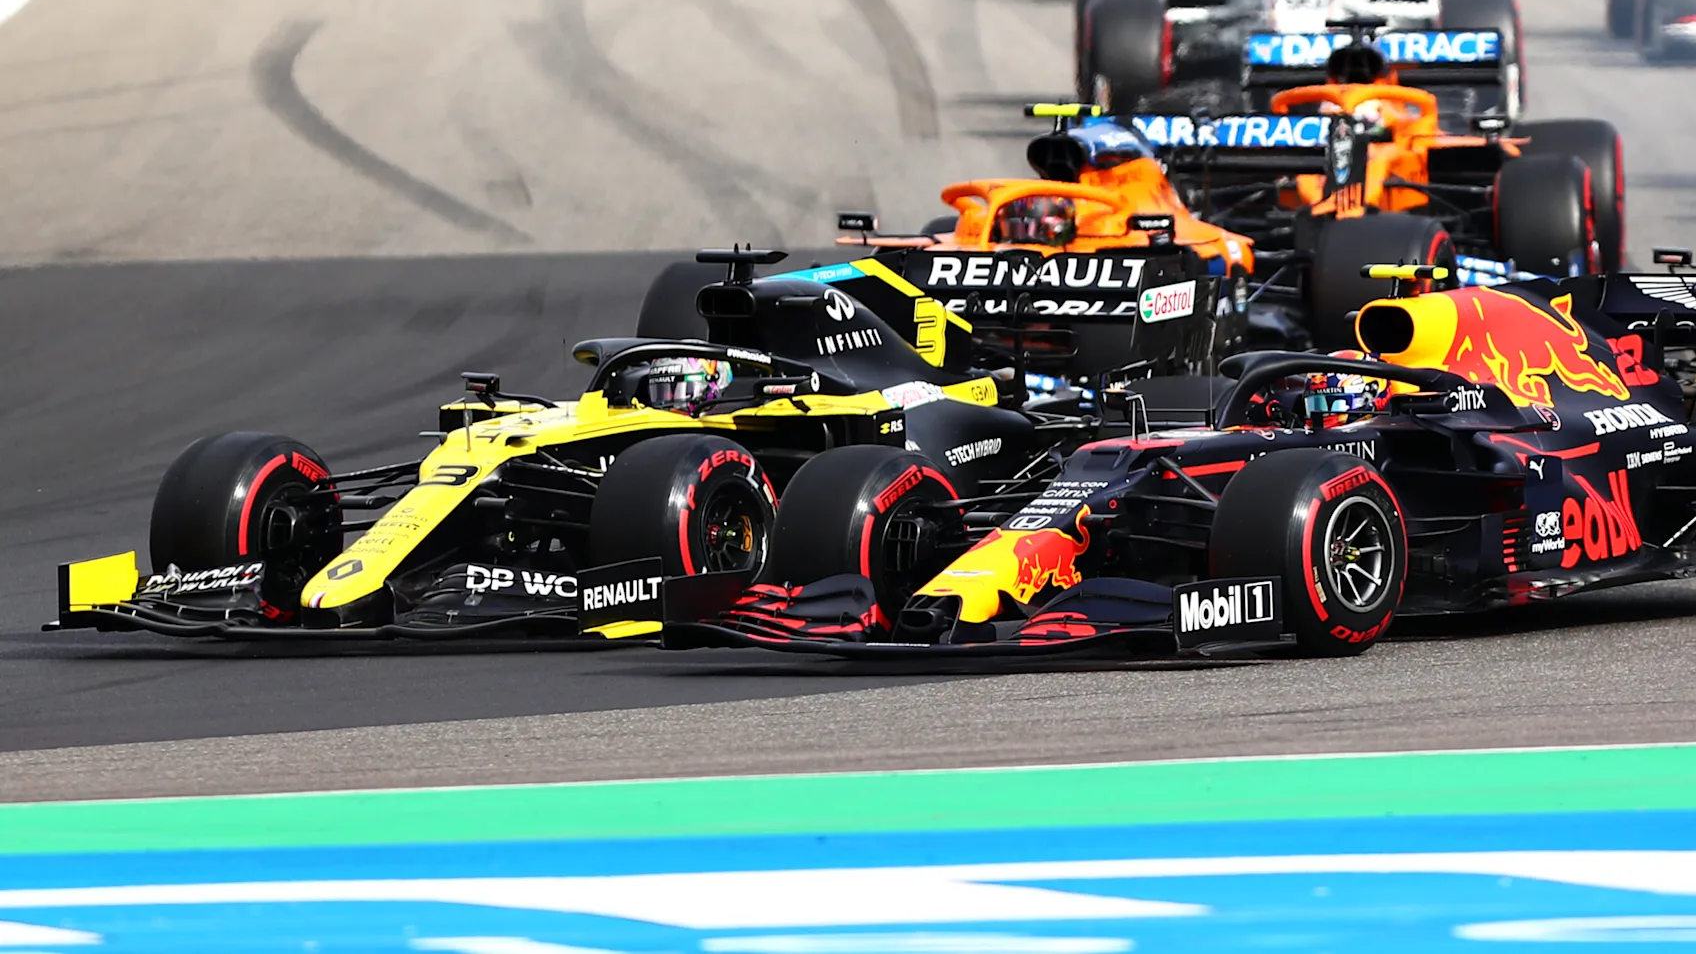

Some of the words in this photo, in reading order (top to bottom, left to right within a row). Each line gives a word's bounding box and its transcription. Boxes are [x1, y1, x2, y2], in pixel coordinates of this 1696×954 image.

[927, 256, 1147, 289] RENAULT
[1153, 286, 1193, 317] Castrol
[816, 328, 882, 356] INFINITI
[1450, 384, 1487, 413] citrix
[1583, 403, 1675, 436] HONDA
[1649, 423, 1689, 440] HYBRID
[1626, 451, 1642, 470] IBM
[873, 463, 924, 515] PIRELLI
[1319, 465, 1372, 502] PIRELLI
[1531, 536, 1566, 554] myWorld
[466, 563, 515, 594] DP
[583, 576, 664, 612] RENAULT
[1180, 584, 1242, 633] Mobil
